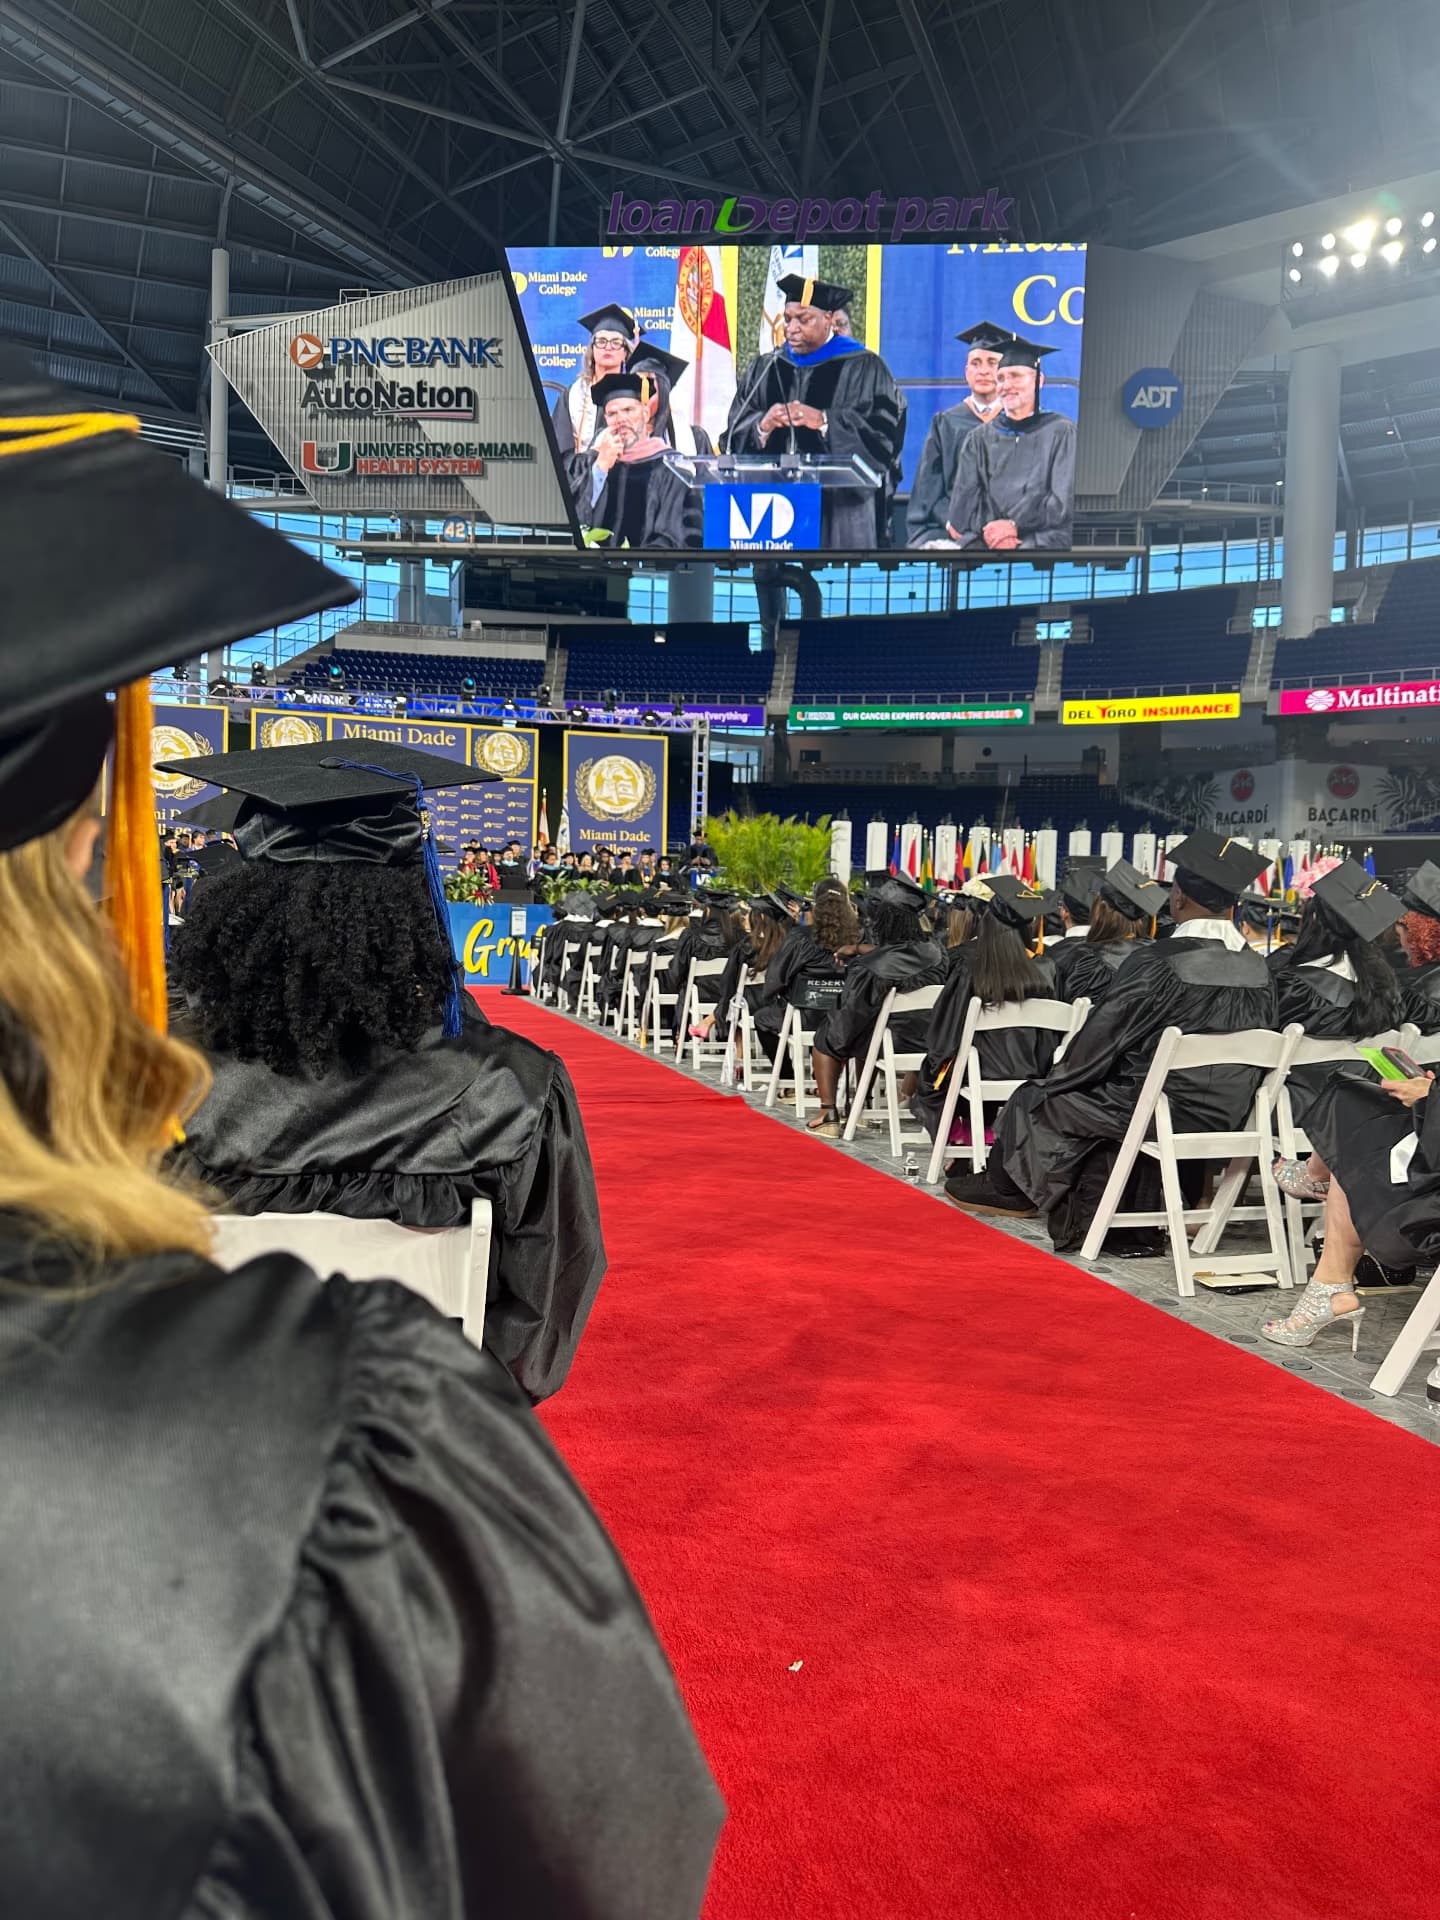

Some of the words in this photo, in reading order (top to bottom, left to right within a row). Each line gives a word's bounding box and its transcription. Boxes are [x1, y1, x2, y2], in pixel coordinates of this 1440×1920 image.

[607, 190, 885, 242] loanDepot
[891, 187, 1014, 243] park
[528, 272, 559, 283] Miami
[561, 272, 588, 283] Dade
[538, 284, 577, 296] College
[634, 307, 665, 318] Miami
[644, 319, 672, 330] Colle
[561, 344, 588, 355] Dade
[538, 356, 577, 368] College
[300, 379, 474, 410] AutoNation
[1131, 386, 1178, 409] ADT
[357, 442, 452, 457] UNIVERSITY
[453, 442, 475, 457] OF
[478, 442, 532, 458] MIAMI
[356, 458, 416, 474] HEALTH
[419, 458, 482, 475] SYSTEM
[445, 522, 466, 538] 42
[730, 540, 763, 550] Miami
[766, 540, 793, 550] Dade
[705, 709, 748, 722] Everything
[860, 712, 890, 720] CANCER
[1068, 709, 1094, 720] DEL
[1096, 704, 1137, 718] TORO
[1142, 704, 1234, 718] INSURANCE
[343, 723, 402, 744] Miami
[407, 729, 456, 746] Dade
[1216, 804, 1269, 825] BACARDÍ
[1308, 804, 1377, 823] BACARDÍ
[580, 829, 617, 840] Miami
[619, 830, 651, 842] Dade
[592, 844, 638, 855] Cllege
